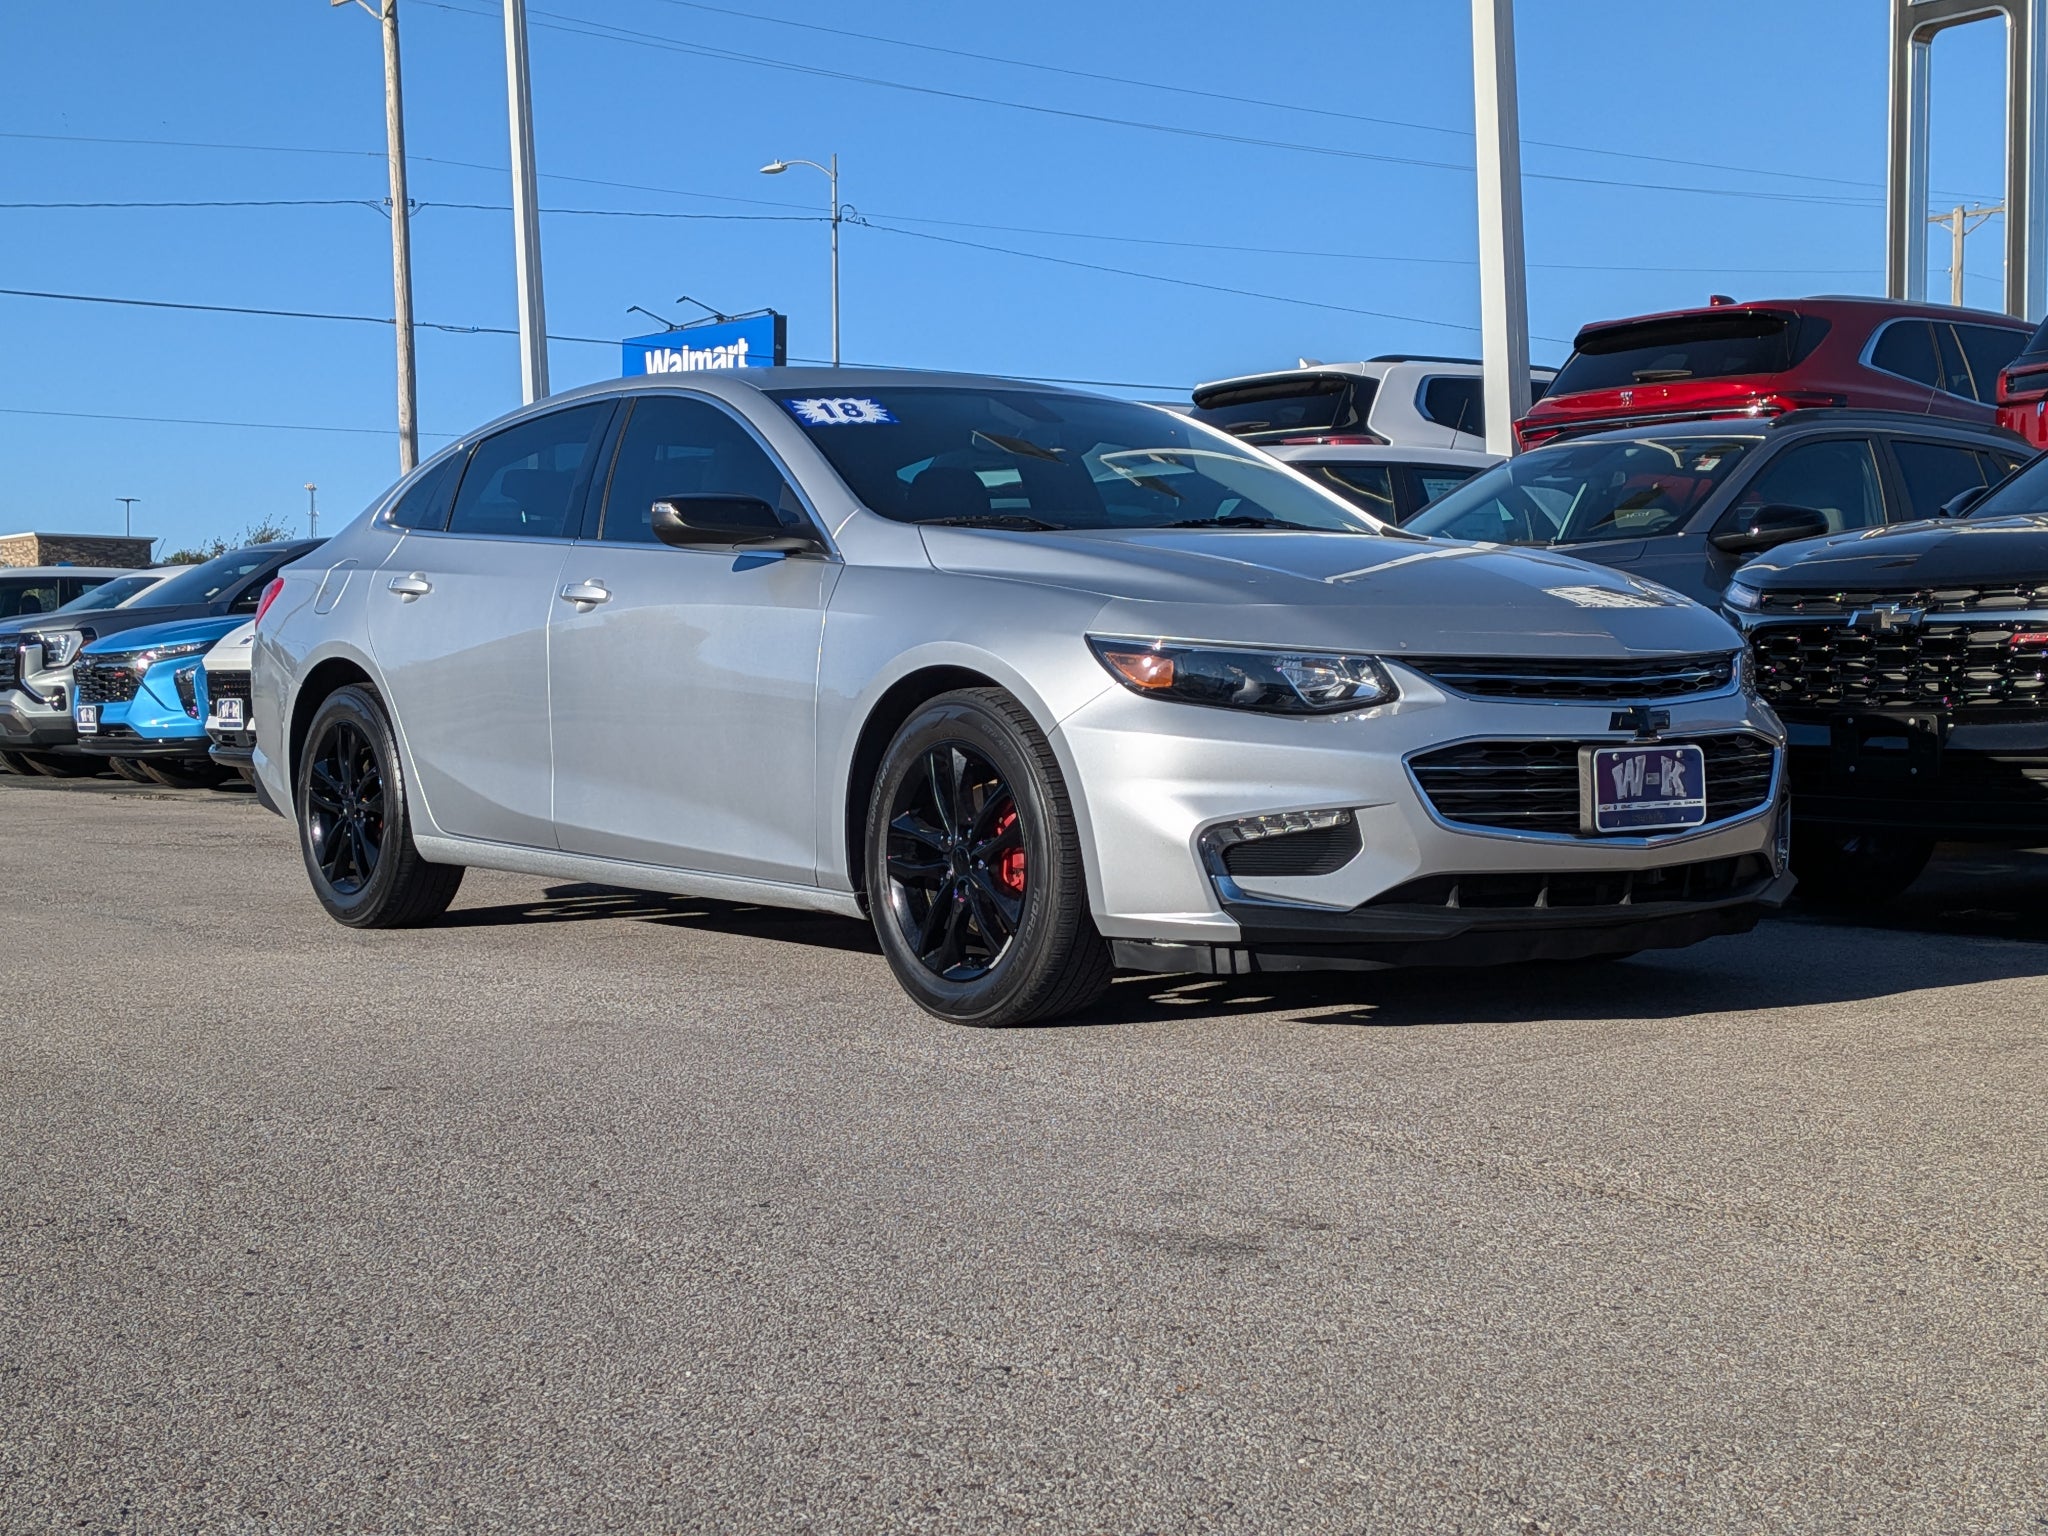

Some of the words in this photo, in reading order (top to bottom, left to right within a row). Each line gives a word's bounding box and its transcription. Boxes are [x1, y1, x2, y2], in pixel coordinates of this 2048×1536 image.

[645, 337, 748, 375] Walmart
[816, 402, 864, 419] 18
[1611, 754, 1687, 800] W-K
